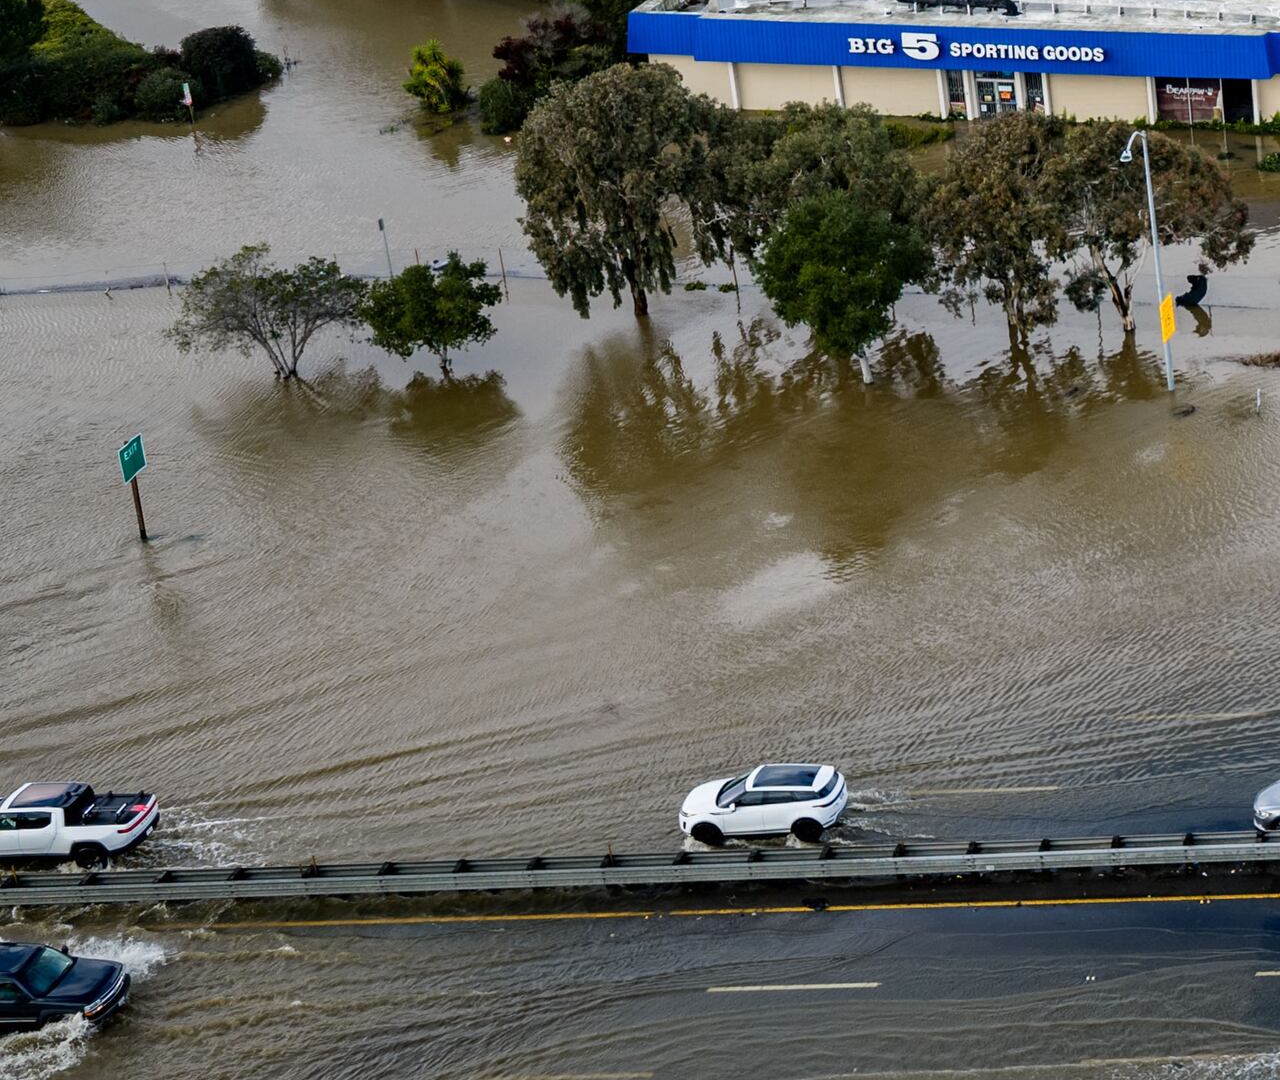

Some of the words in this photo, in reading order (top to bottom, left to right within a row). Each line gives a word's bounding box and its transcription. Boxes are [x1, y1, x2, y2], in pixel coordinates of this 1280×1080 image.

[847, 38, 895, 55] BIG
[901, 32, 940, 61] 5
[949, 42, 1039, 60] SPORTING
[1043, 45, 1104, 62] GOODS
[123, 441, 138, 461] EXIT
